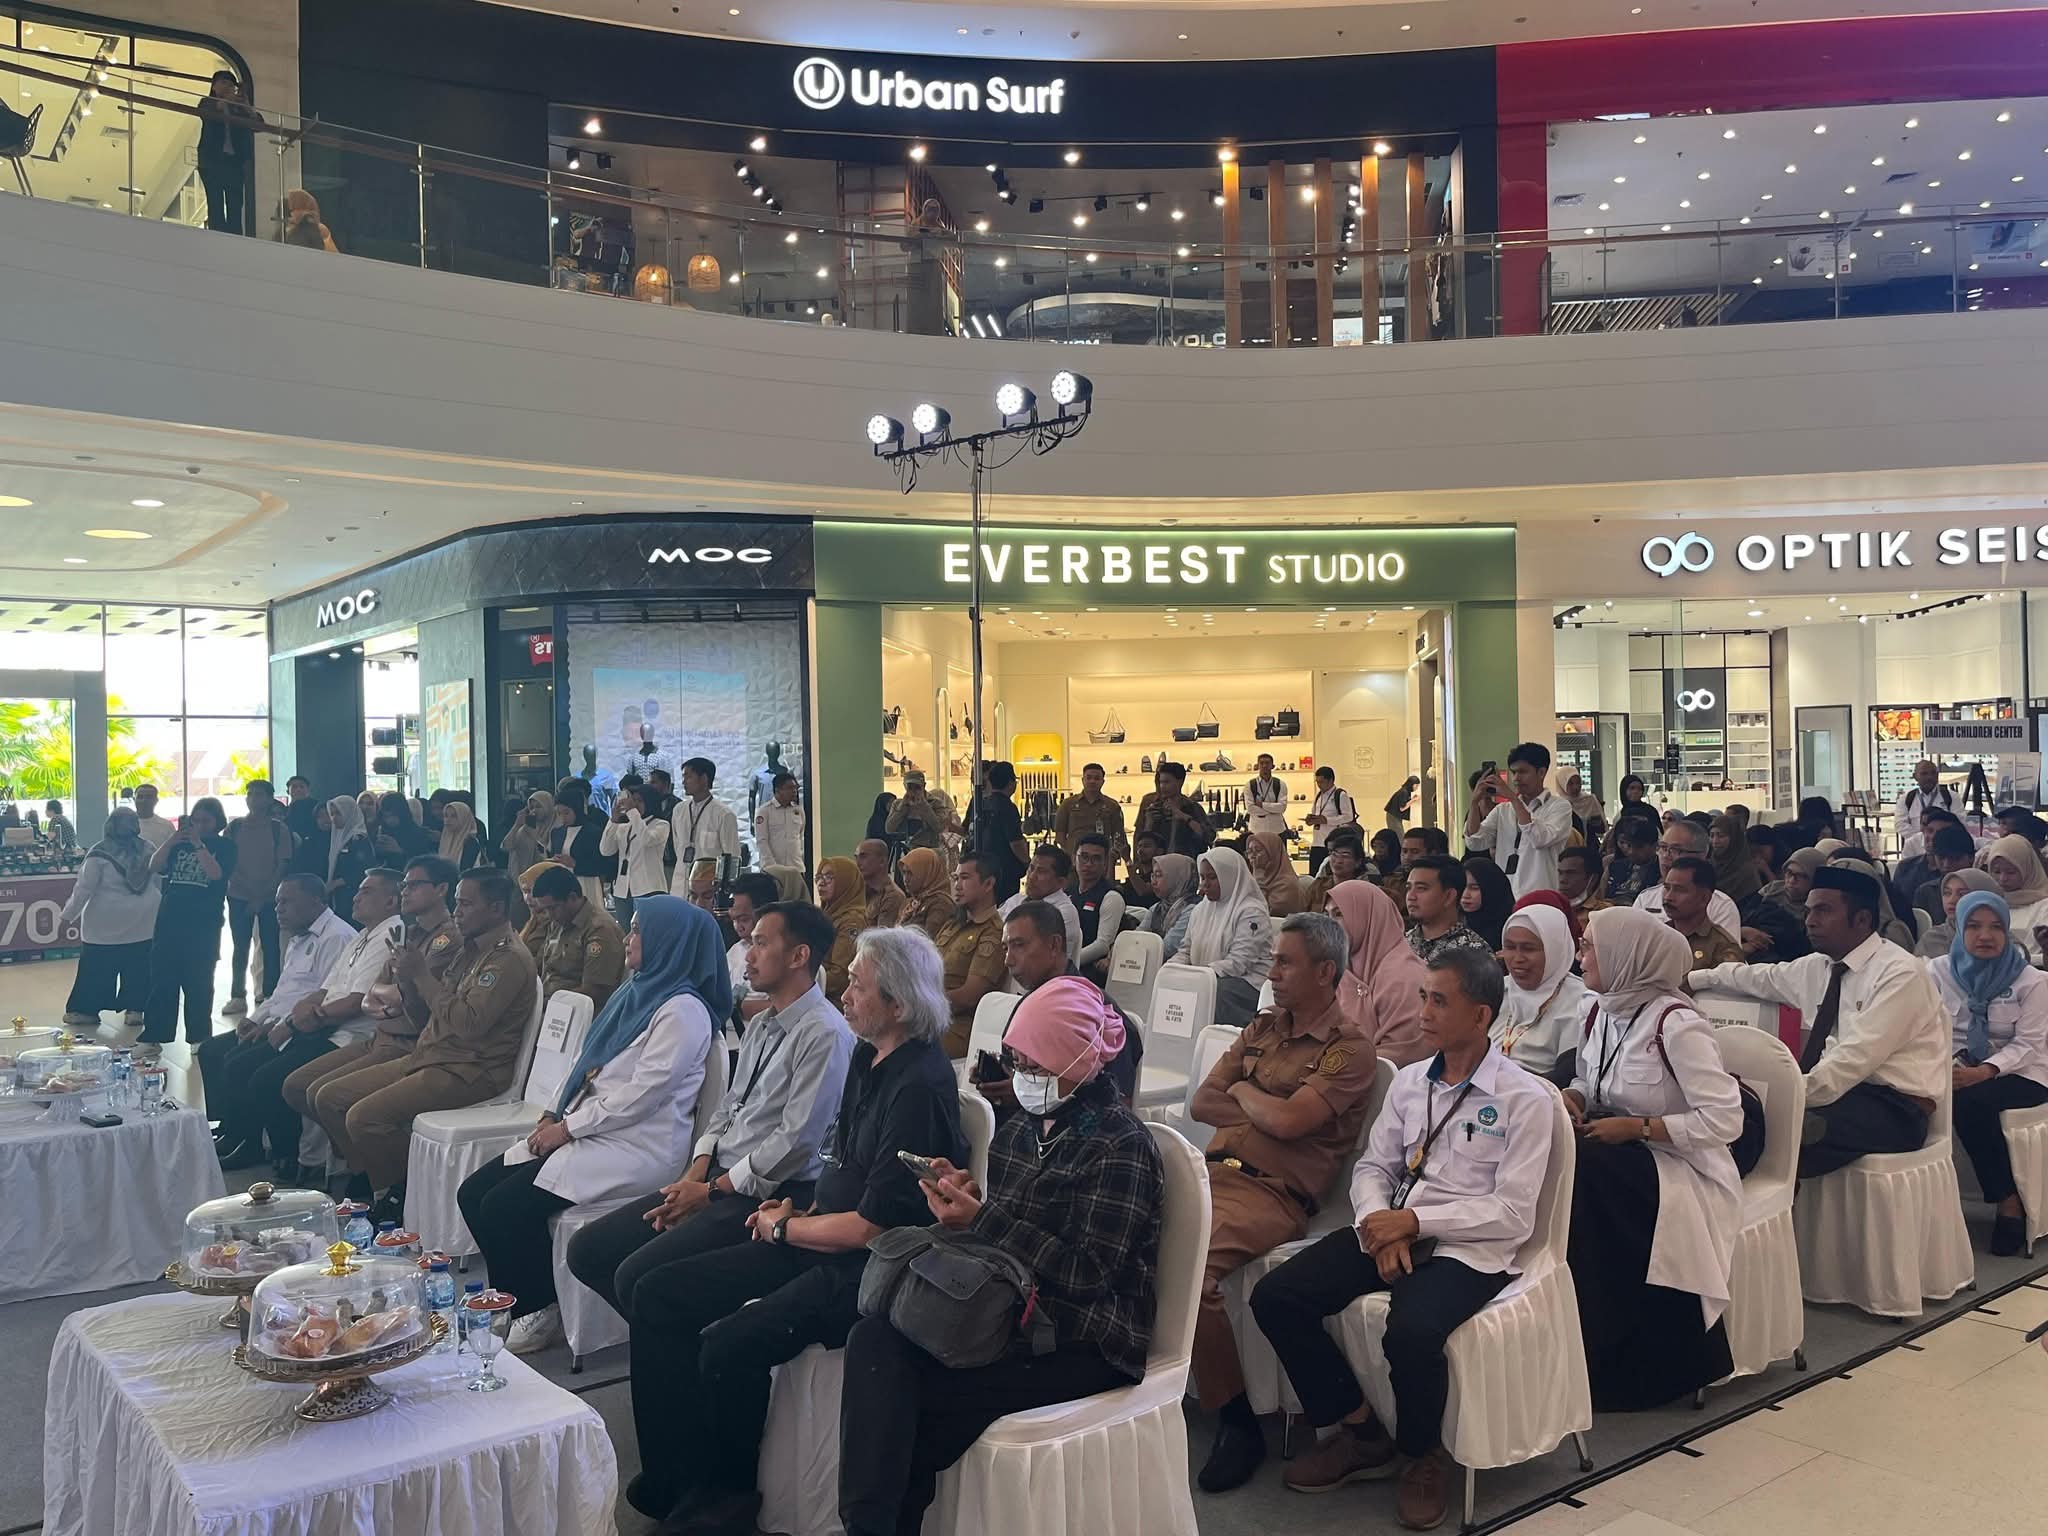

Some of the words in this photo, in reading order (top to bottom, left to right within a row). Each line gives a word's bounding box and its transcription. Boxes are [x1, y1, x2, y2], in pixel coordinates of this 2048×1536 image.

[851, 68, 979, 111] Urban
[985, 76, 1067, 115] Surf
[646, 546, 773, 564] MOC
[942, 542, 1247, 585] EVERBEST
[1267, 552, 1406, 584] STUDIO
[1736, 530, 1913, 573] OPTIK
[316, 588, 377, 629] MOC
[1955, 725, 1993, 739] CHILDREN
[1994, 725, 2023, 739] CENTER
[0, 899, 62, 946] 70
